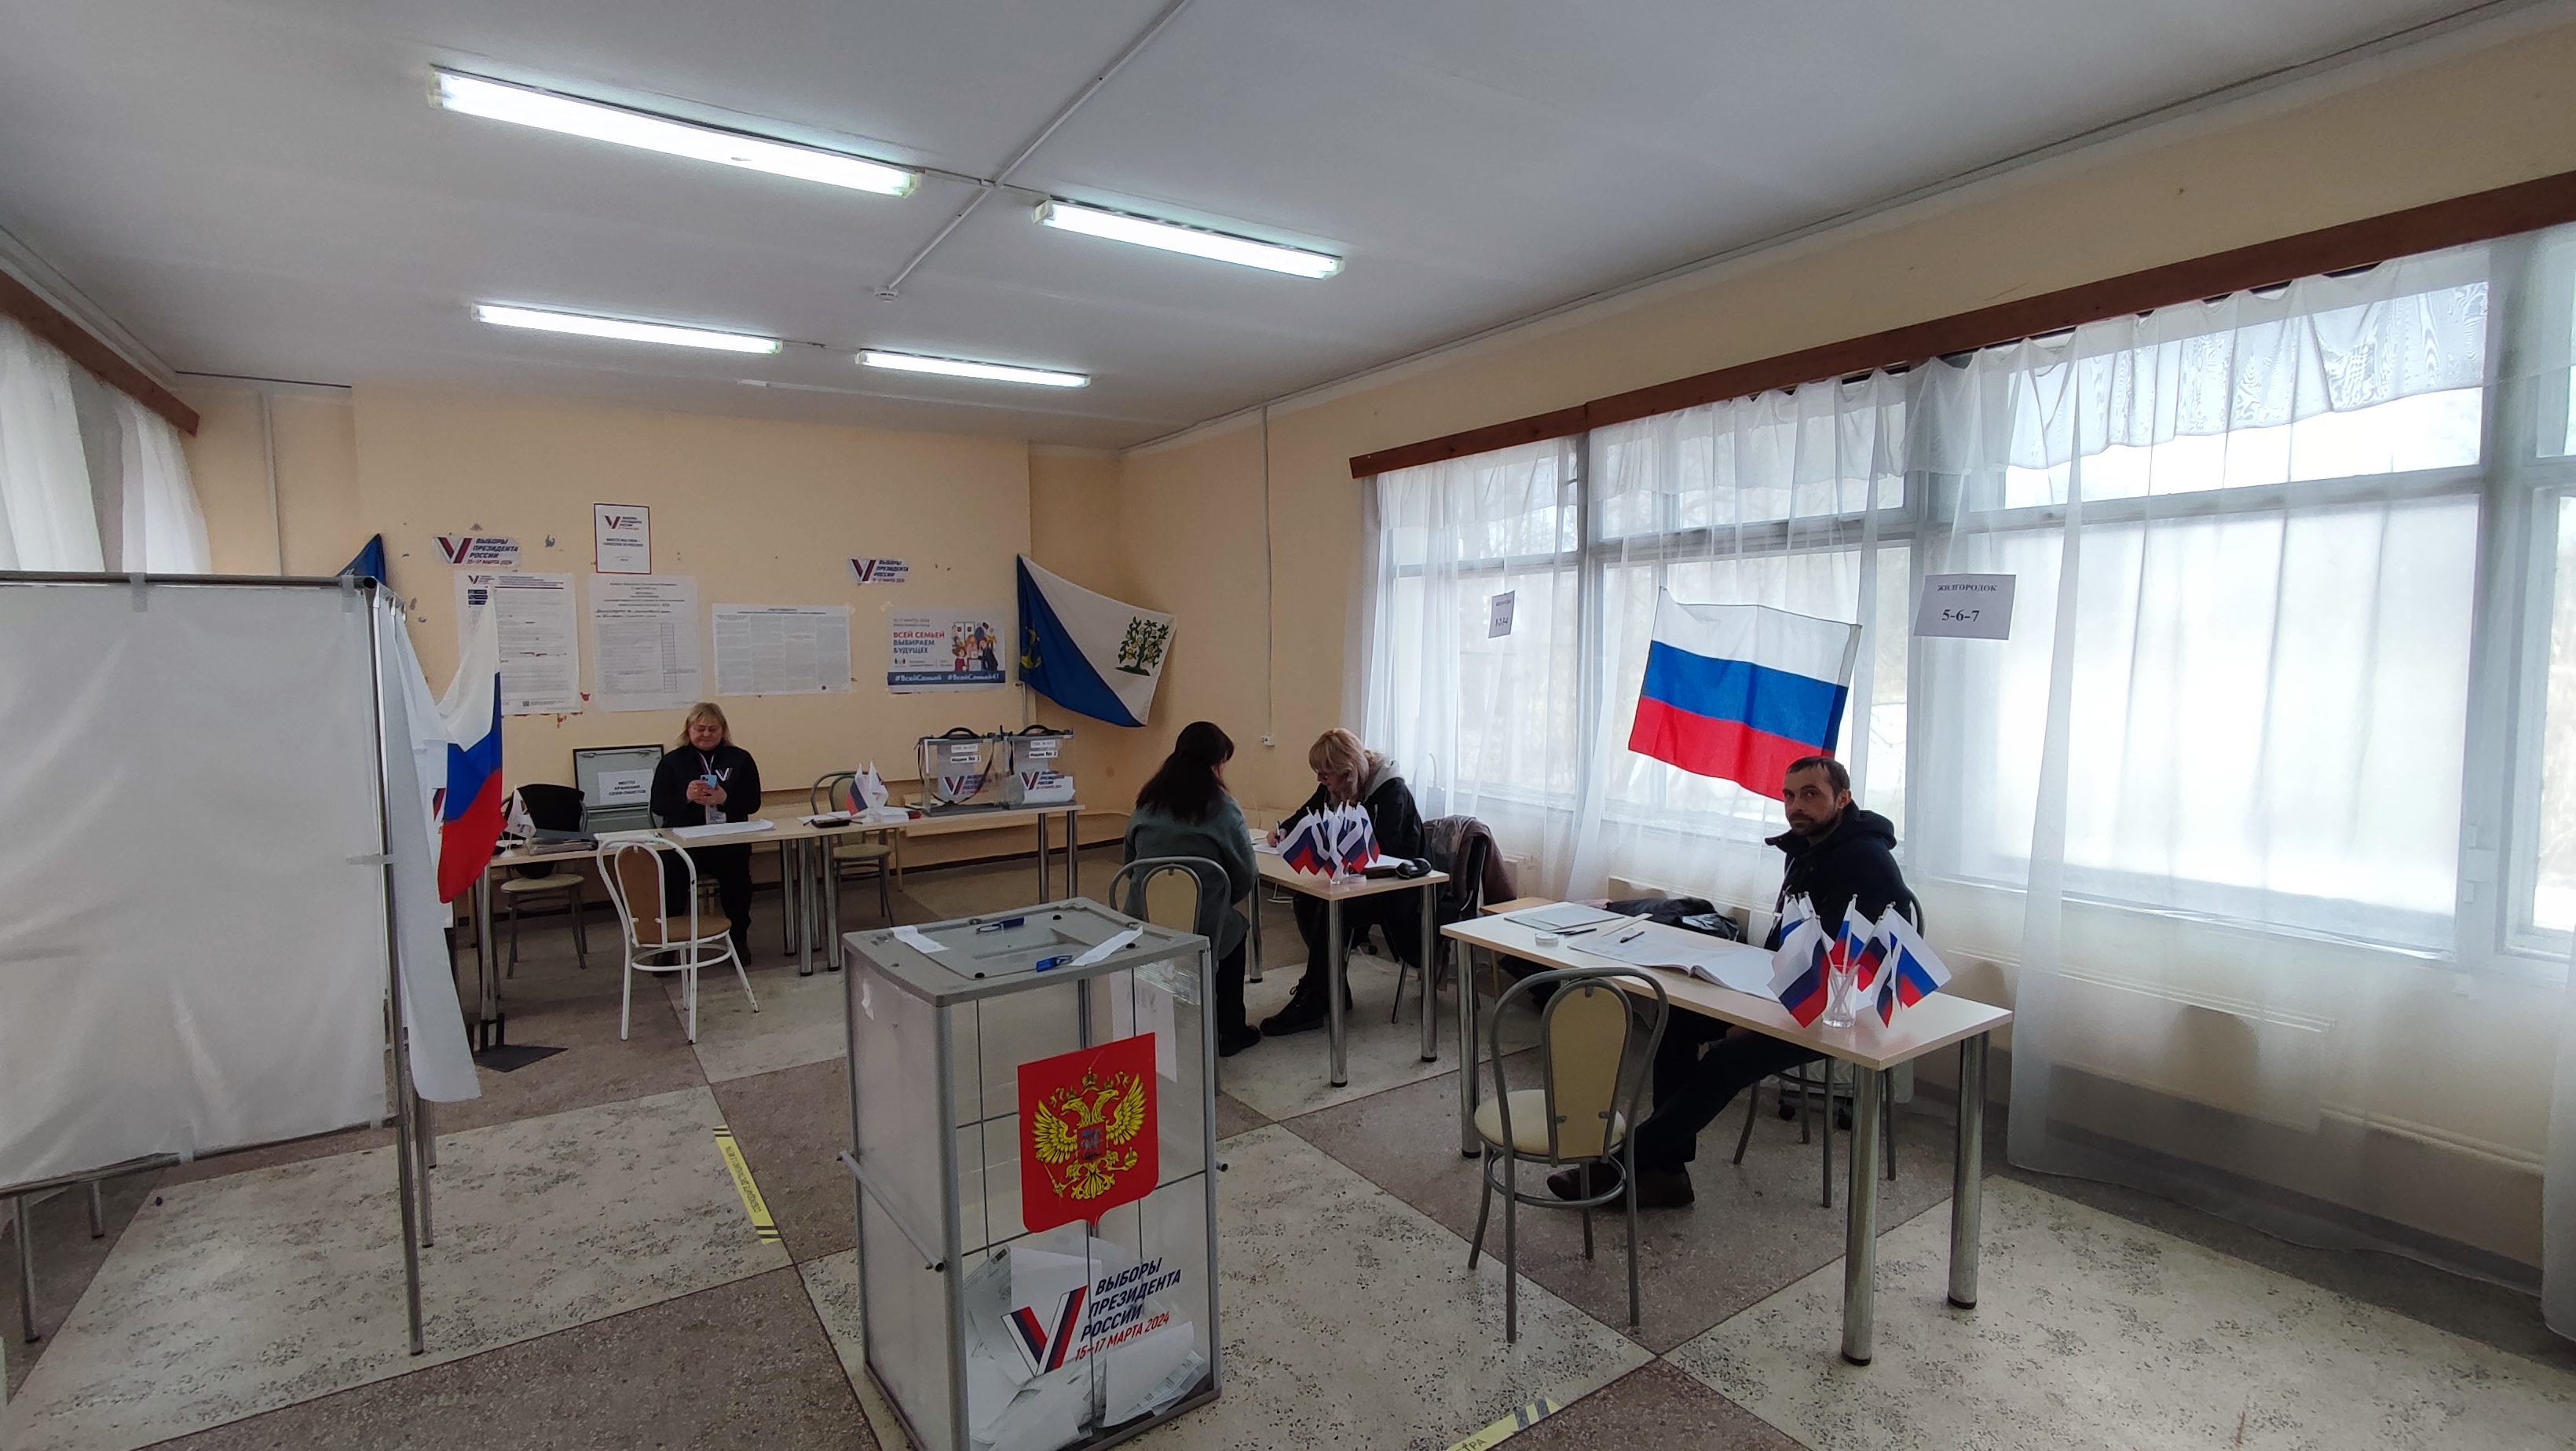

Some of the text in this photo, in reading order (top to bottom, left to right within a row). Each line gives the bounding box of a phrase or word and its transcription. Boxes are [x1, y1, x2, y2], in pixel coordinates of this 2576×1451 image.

[1941, 609, 1980, 623] 5-6-7
[1088, 1269, 1181, 1319] ПРЕЗИДЕНТА
[1095, 1257, 1162, 1296] ВЫБОРЫ
[1075, 1311, 1170, 1361] 15-17 МАРТА 2024
[1080, 1303, 1143, 1343] РОССИИ
